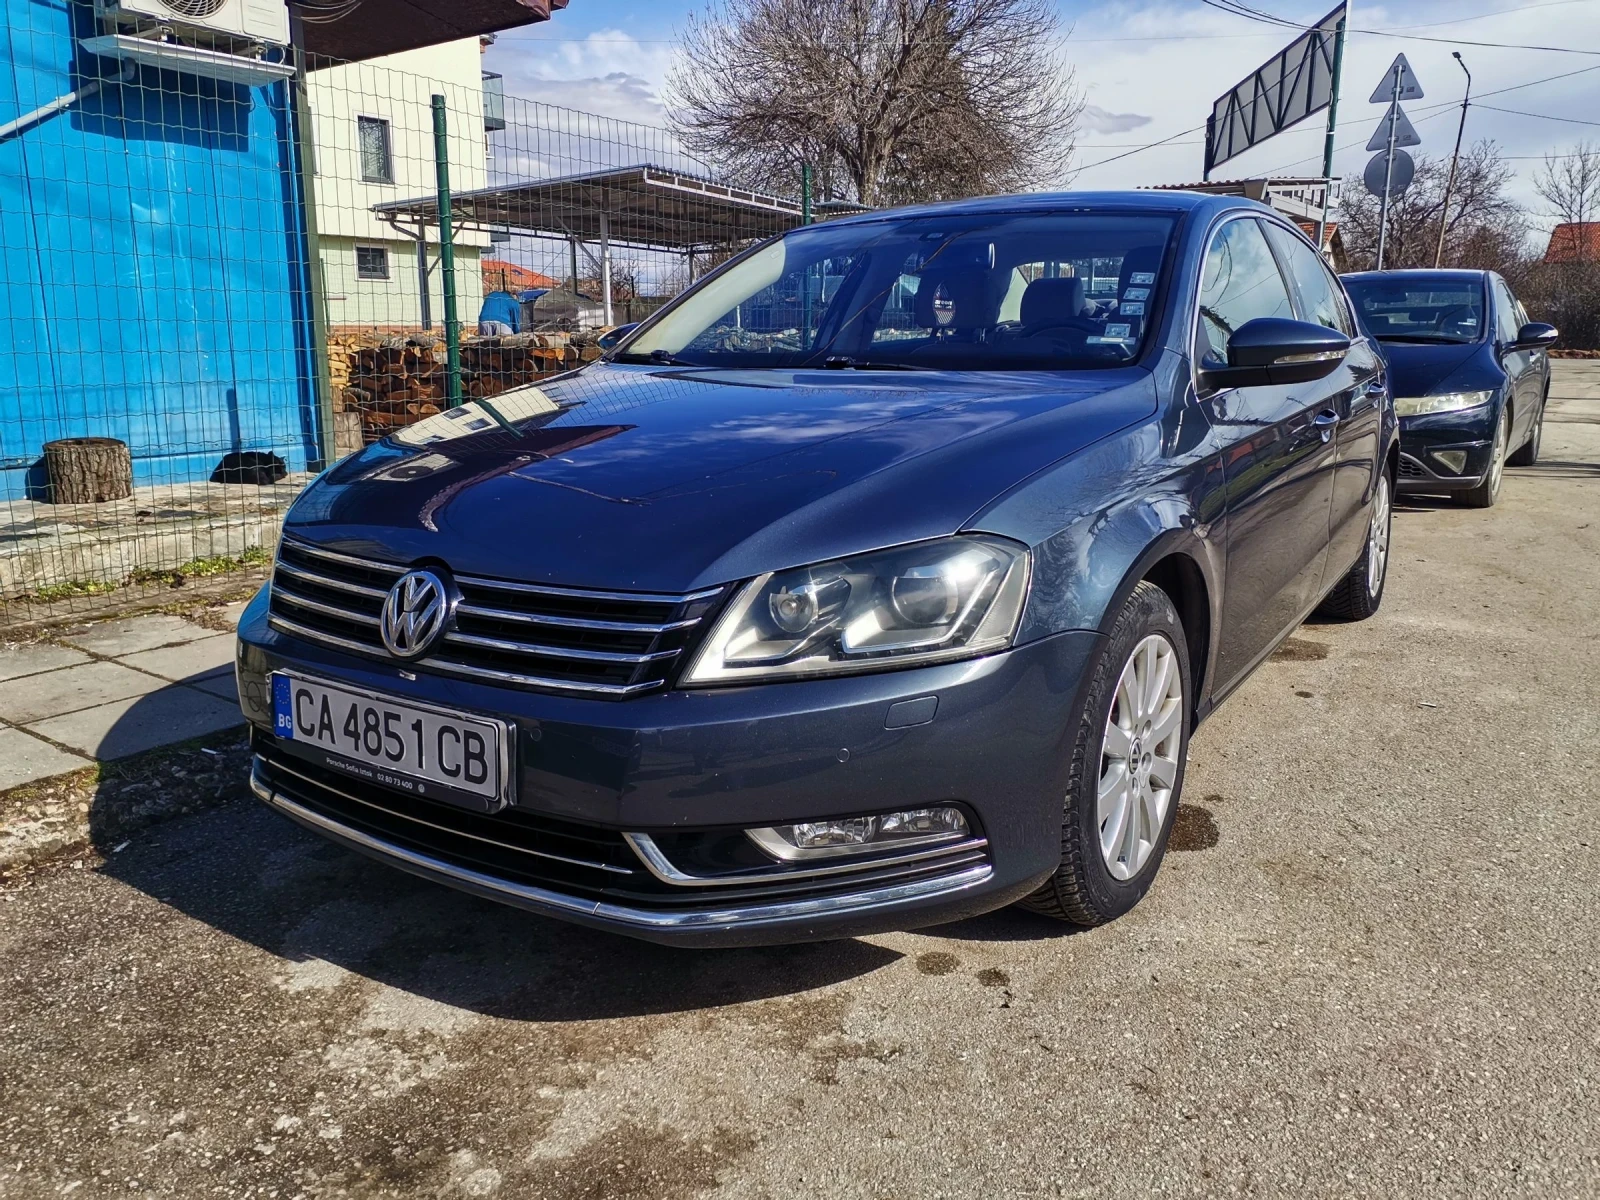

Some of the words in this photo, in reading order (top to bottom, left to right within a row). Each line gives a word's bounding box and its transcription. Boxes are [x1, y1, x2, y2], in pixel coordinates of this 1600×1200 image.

[278, 713, 292, 730] BG
[295, 688, 336, 745] CA
[343, 703, 425, 770] 4851
[438, 725, 488, 784] CB
[326, 757, 345, 769] Porsche
[346, 763, 359, 773] Sofia
[377, 773, 384, 781] 02
[393, 778, 401, 786] 73
[401, 781, 413, 789] 400
